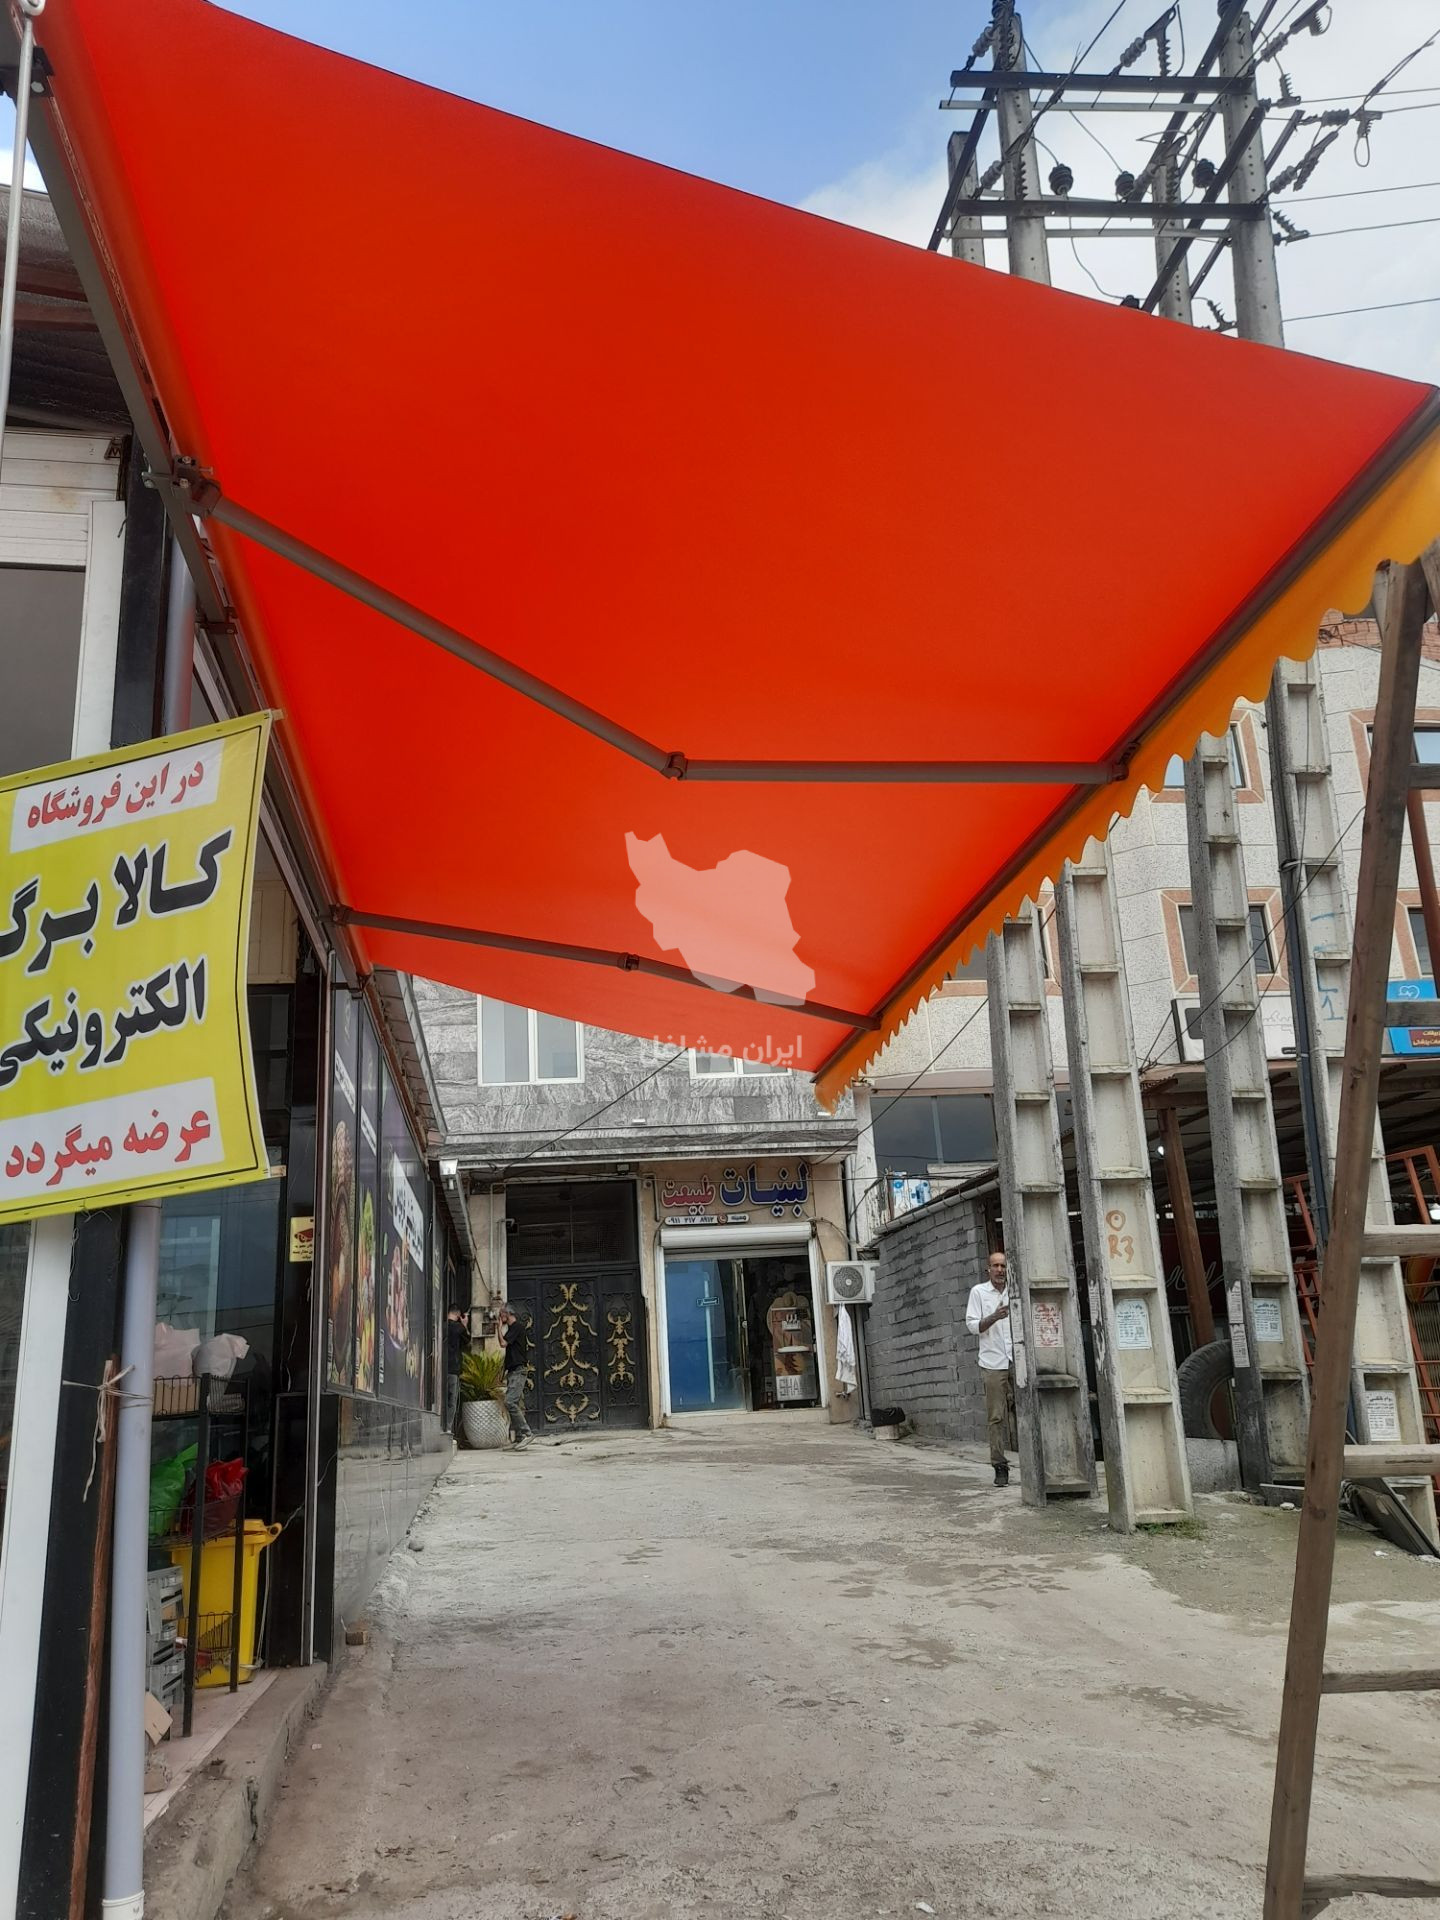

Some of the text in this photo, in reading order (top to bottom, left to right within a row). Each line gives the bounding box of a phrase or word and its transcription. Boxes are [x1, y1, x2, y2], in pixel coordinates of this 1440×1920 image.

[27, 760, 204, 829] در این فروشگاه
[0, 957, 205, 1087] الکترونیکی
[5, 1109, 211, 1187] عرضه میگردد
[661, 1163, 810, 1217] لبنیات طبیعت
